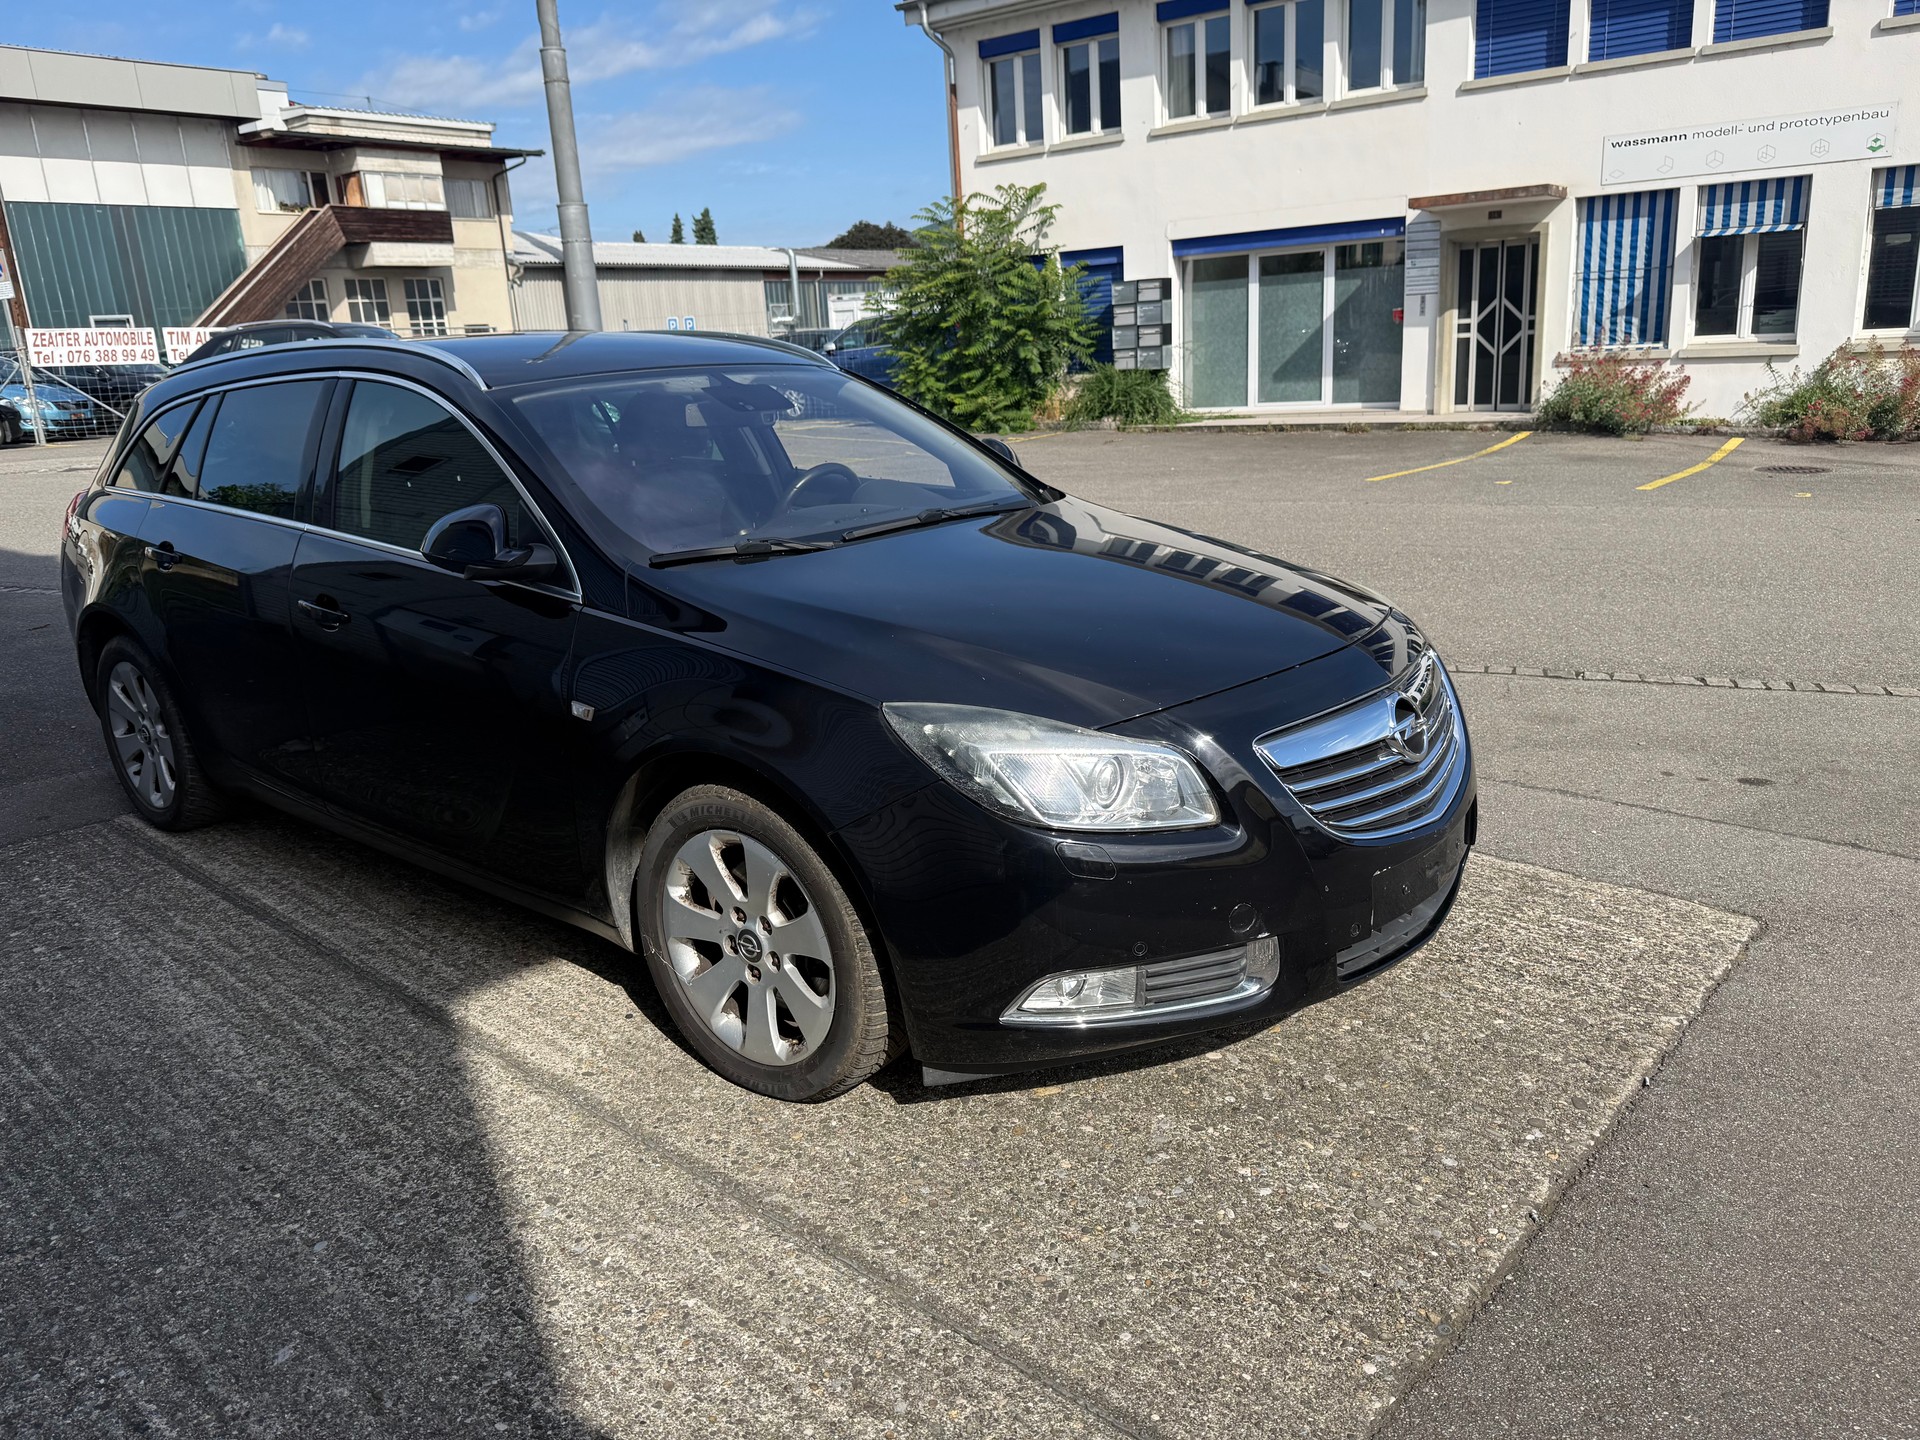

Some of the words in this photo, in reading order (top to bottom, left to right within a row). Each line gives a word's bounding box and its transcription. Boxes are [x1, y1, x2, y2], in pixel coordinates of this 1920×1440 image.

[1611, 132, 1688, 149] wassmann
[1692, 125, 1744, 140] modell-
[1748, 121, 1775, 133] und
[1779, 109, 1890, 132] prototypenbau
[32, 331, 81, 348] ZEAITER
[84, 331, 154, 347] AUTOMOBILE
[167, 330, 191, 346] TIM
[34, 350, 55, 364] Tel
[67, 351, 91, 364] 076
[94, 349, 118, 363] 388
[121, 349, 137, 362] 99
[140, 348, 155, 362] 49
